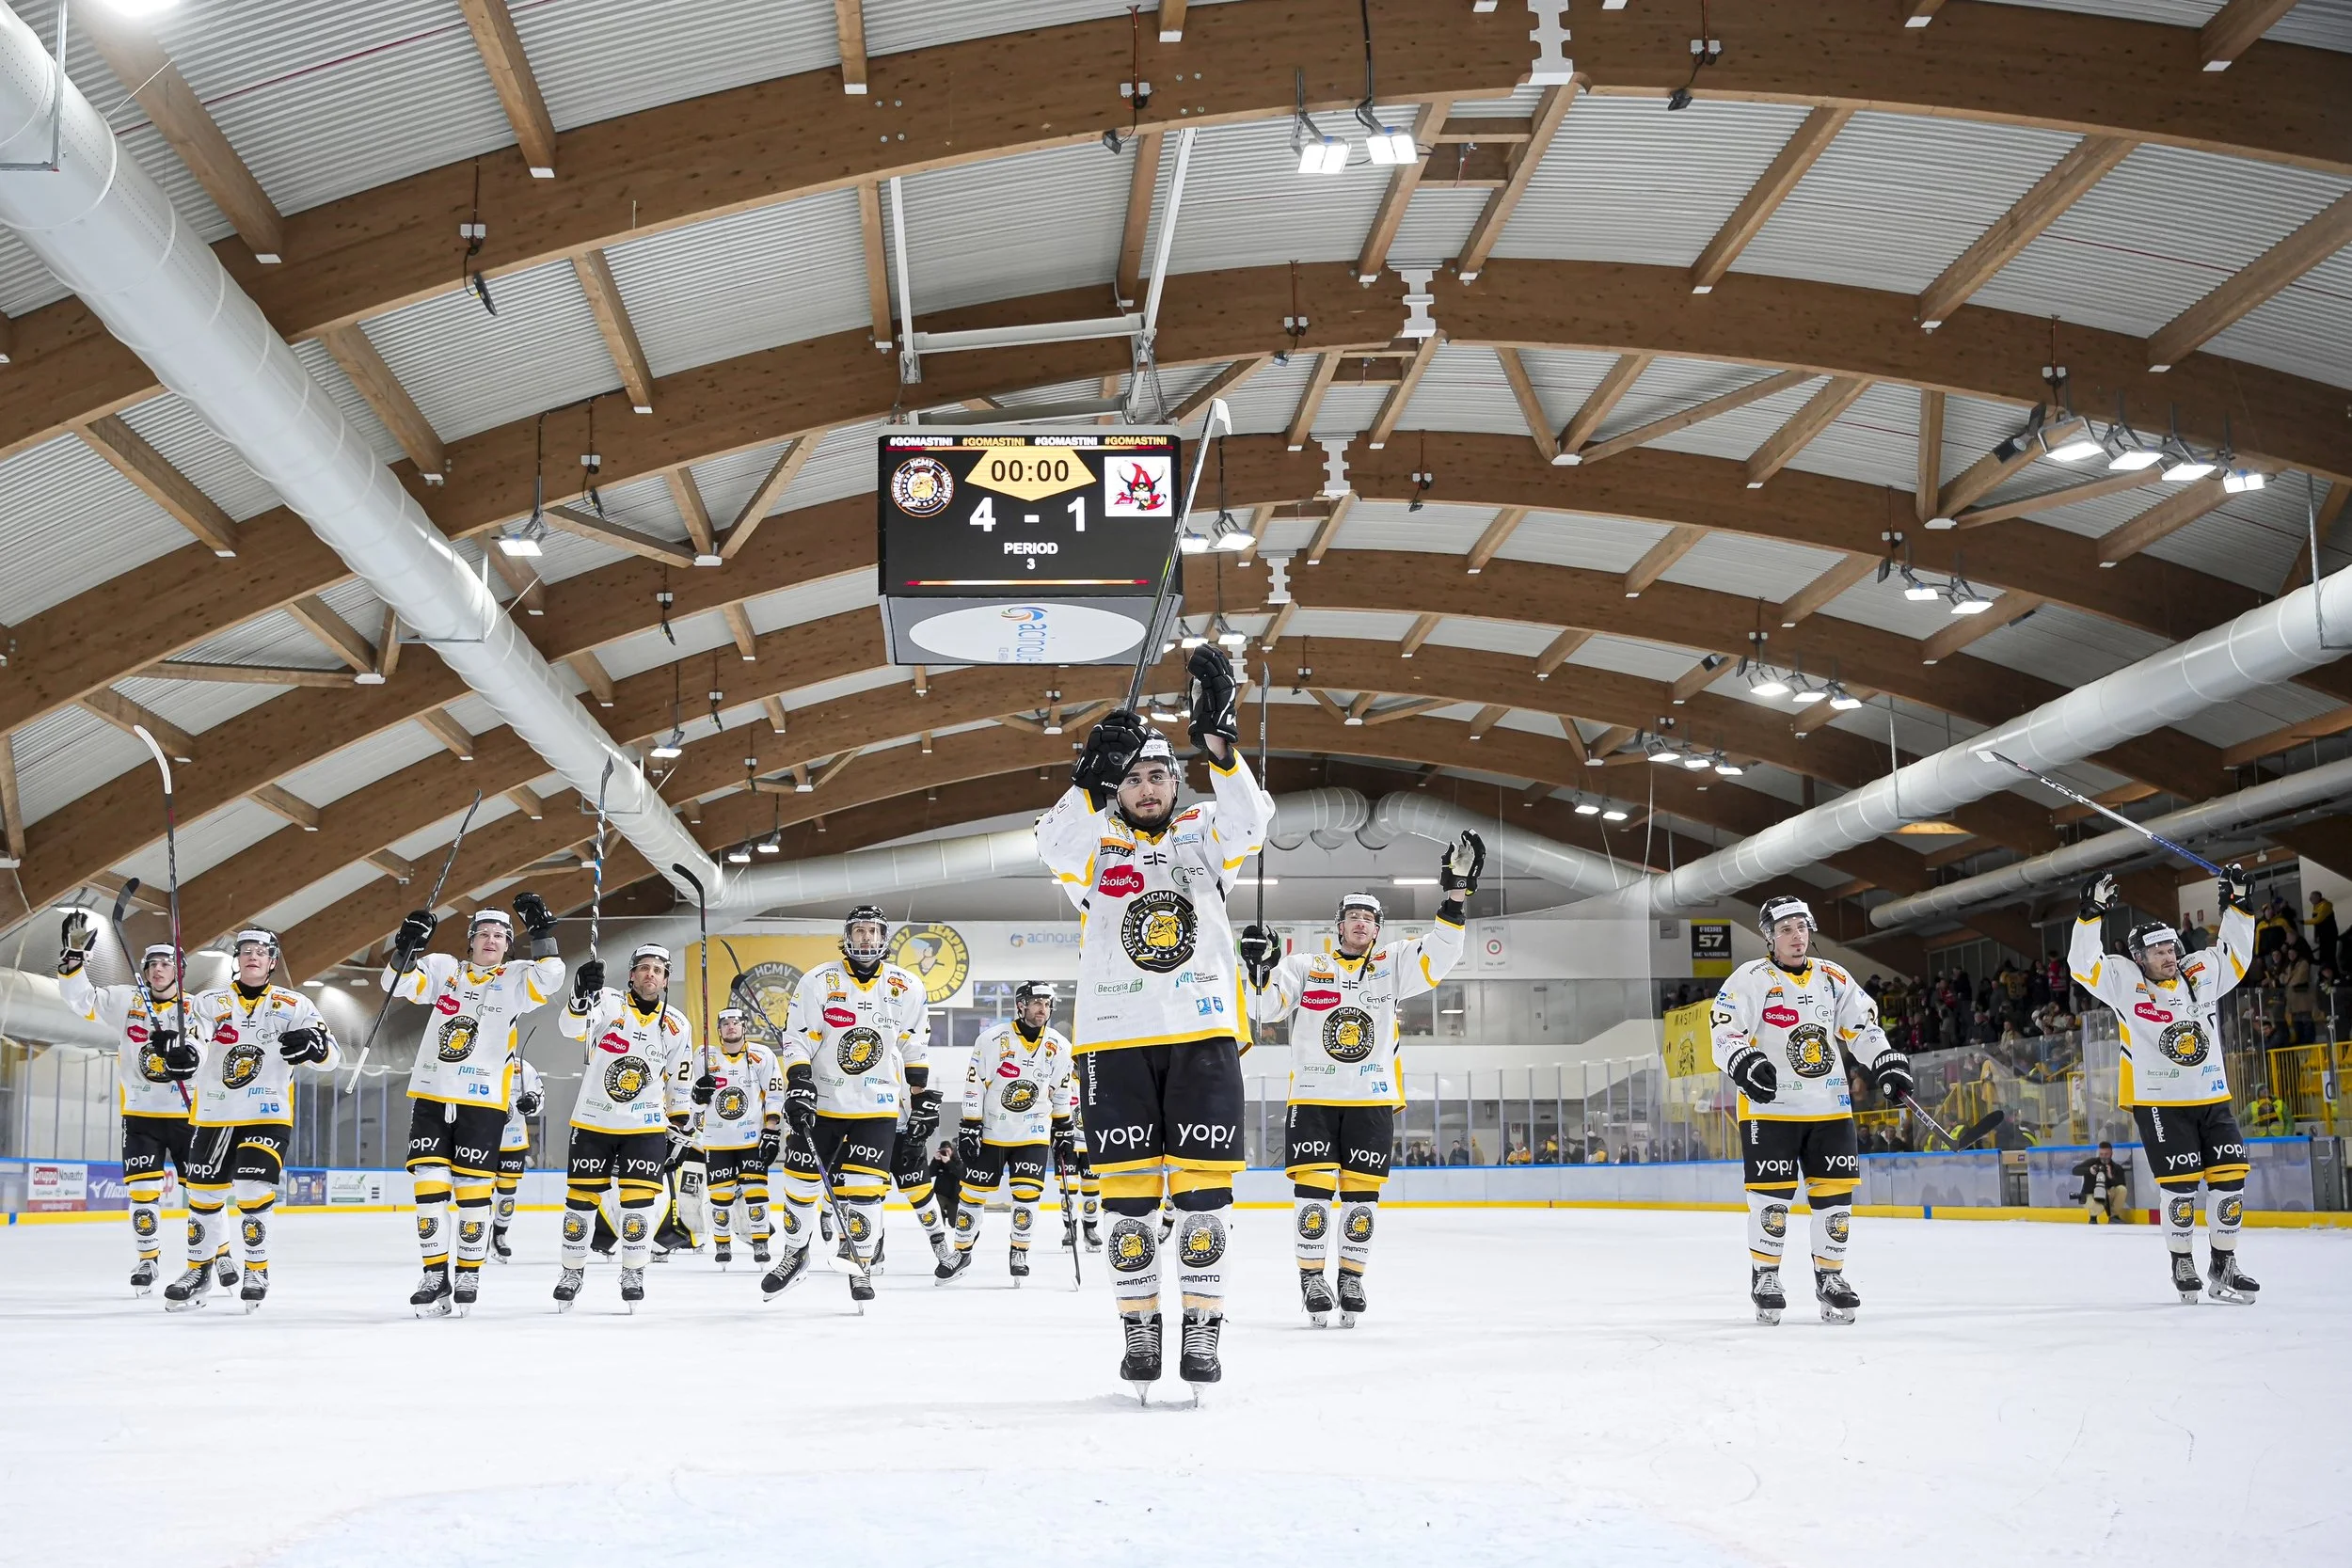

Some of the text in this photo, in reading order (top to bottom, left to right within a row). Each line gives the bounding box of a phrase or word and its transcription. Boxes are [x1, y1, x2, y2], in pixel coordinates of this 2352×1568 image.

[890, 436, 1168, 447] #GOMASTINI #GOMASTINI #GOMASTINI #GOMASTINI
[910, 459, 936, 468] HCMV
[991, 459, 1070, 482] 00:00
[969, 497, 996, 532] 4
[1067, 496, 1086, 532] 1
[1004, 543, 1058, 554] PERIOD
[1026, 558, 1036, 570] 3
[1142, 892, 1178, 904] HCMV
[1698, 934, 1724, 947] 57
[754, 963, 793, 978] HCMV
[1302, 995, 1339, 1005] Scoiattolo
[1338, 1008, 1362, 1017] HCMV
[853, 1028, 874, 1037] HCMV
[1323, 1020, 1333, 1051] VARESE
[1366, 1022, 1375, 1053] HOCKEY
[624, 1056, 644, 1066] HCMV
[1729, 1046, 1761, 1077] WARR
[1875, 1053, 1909, 1069] WARR
[678, 1061, 692, 1081] 2
[786, 1088, 816, 1099] CCM
[2151, 1106, 2166, 1143] PRIMATO
[1095, 1123, 1153, 1154] yop!
[1177, 1123, 1237, 1149] yop!
[454, 1145, 489, 1164] yop!
[849, 1144, 884, 1164] yop!
[1293, 1140, 1331, 1159] yop!
[2213, 1143, 2247, 1160] yop!
[125, 1154, 155, 1172] yop!
[501, 1160, 523, 1170] yop!
[572, 1158, 607, 1173] yop!
[1348, 1148, 1388, 1169] yop!
[1824, 1155, 1859, 1171] yop!
[2166, 1151, 2201, 1171] yop!
[627, 1158, 661, 1176] yop!
[709, 1167, 733, 1181] yop!
[965, 1167, 994, 1183] yop!
[1014, 1161, 1043, 1176] yop!
[1756, 1159, 1794, 1176] yop!
[898, 1170, 924, 1185] yop!
[104, 1181, 130, 1199] Mizu
[1181, 1275, 1220, 1284] PRIMATO
